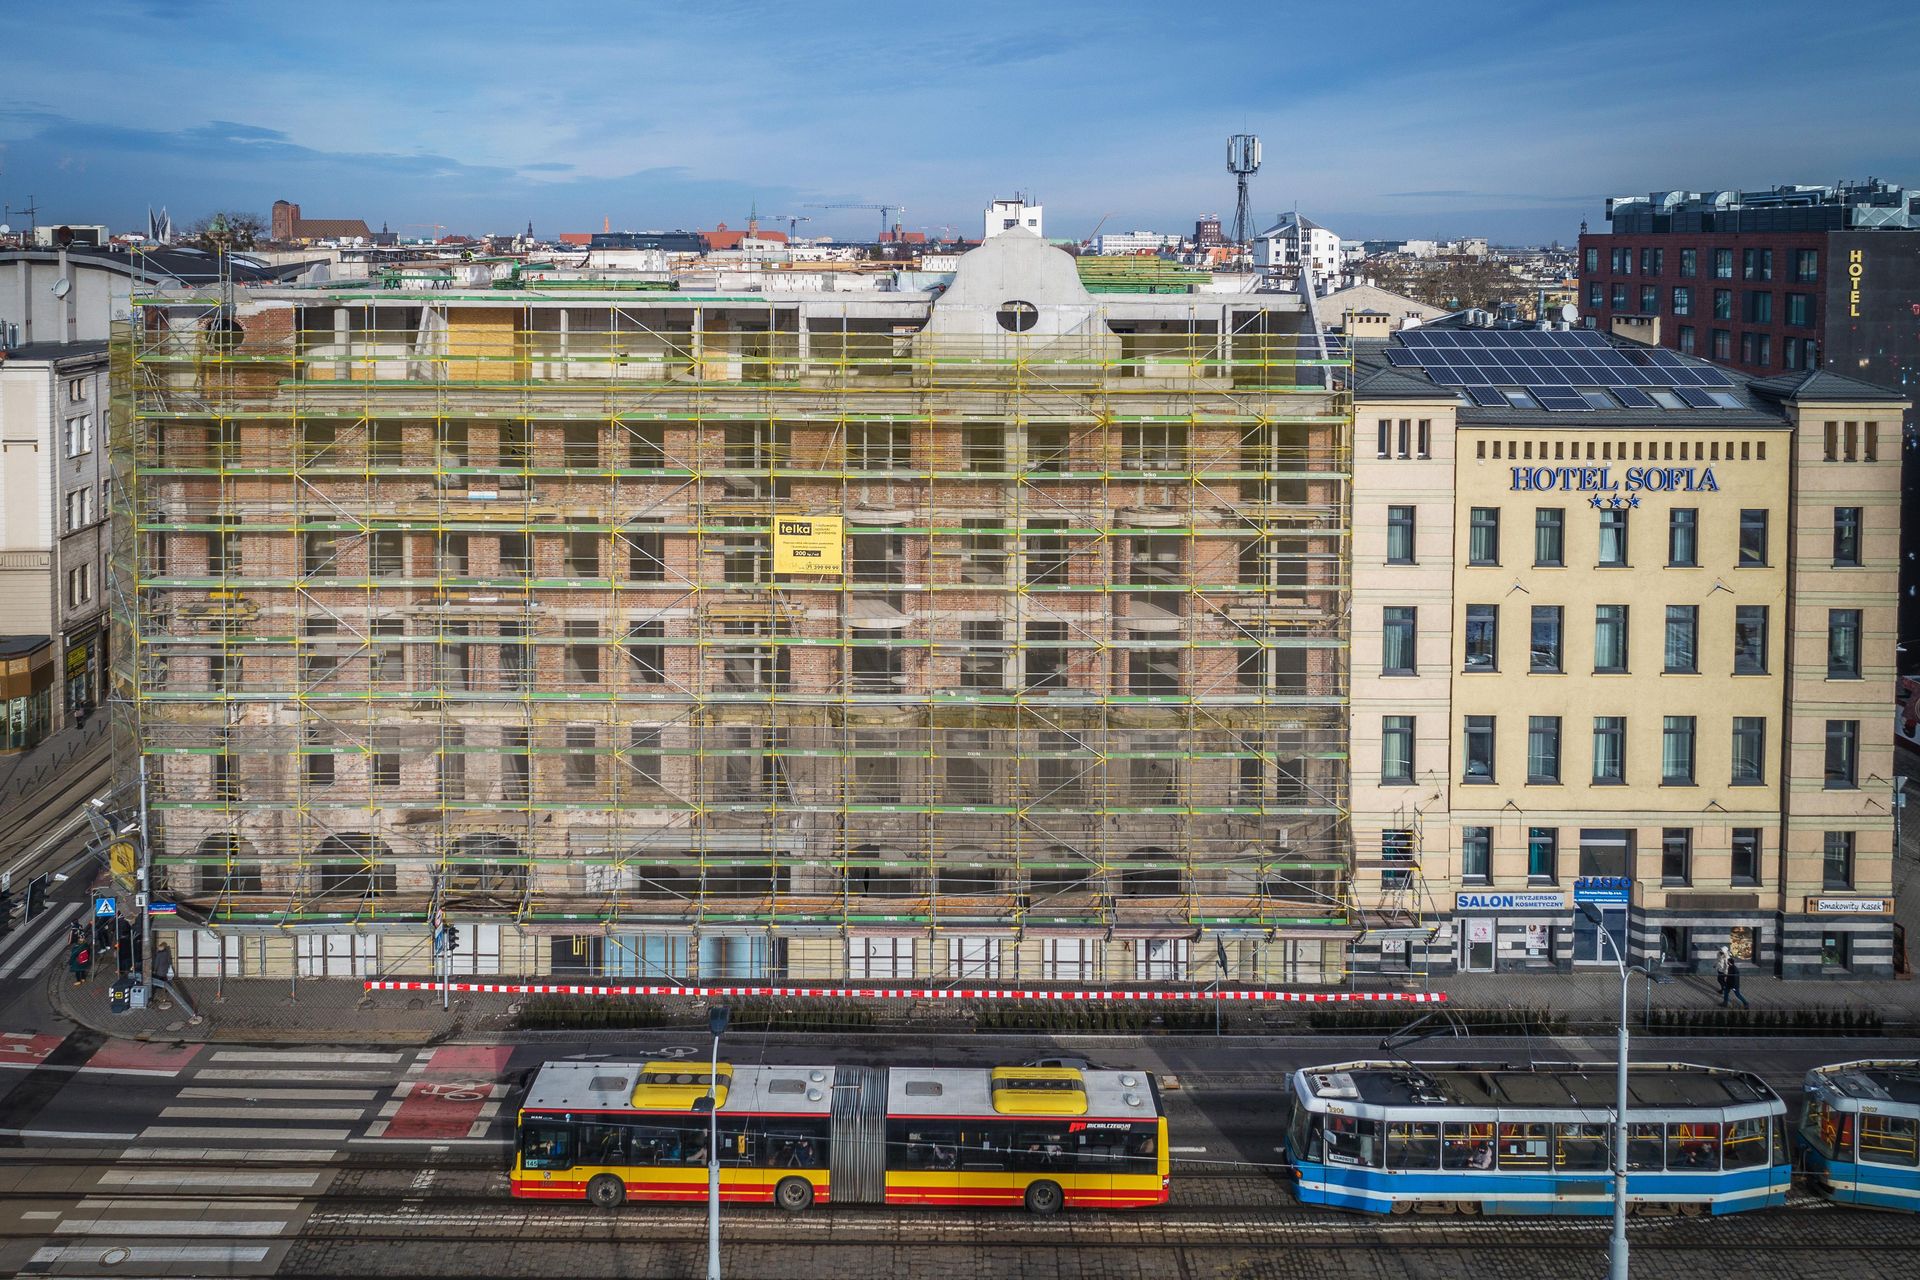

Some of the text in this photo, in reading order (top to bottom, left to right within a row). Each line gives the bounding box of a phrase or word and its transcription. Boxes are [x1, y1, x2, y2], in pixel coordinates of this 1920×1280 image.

[1849, 250, 1862, 316] HOTEL
[1510, 466, 1720, 492] HOTEL SOFIA
[781, 524, 810, 534] telka
[1458, 896, 1513, 907] SALON
[1820, 902, 1859, 910] Smakowity
